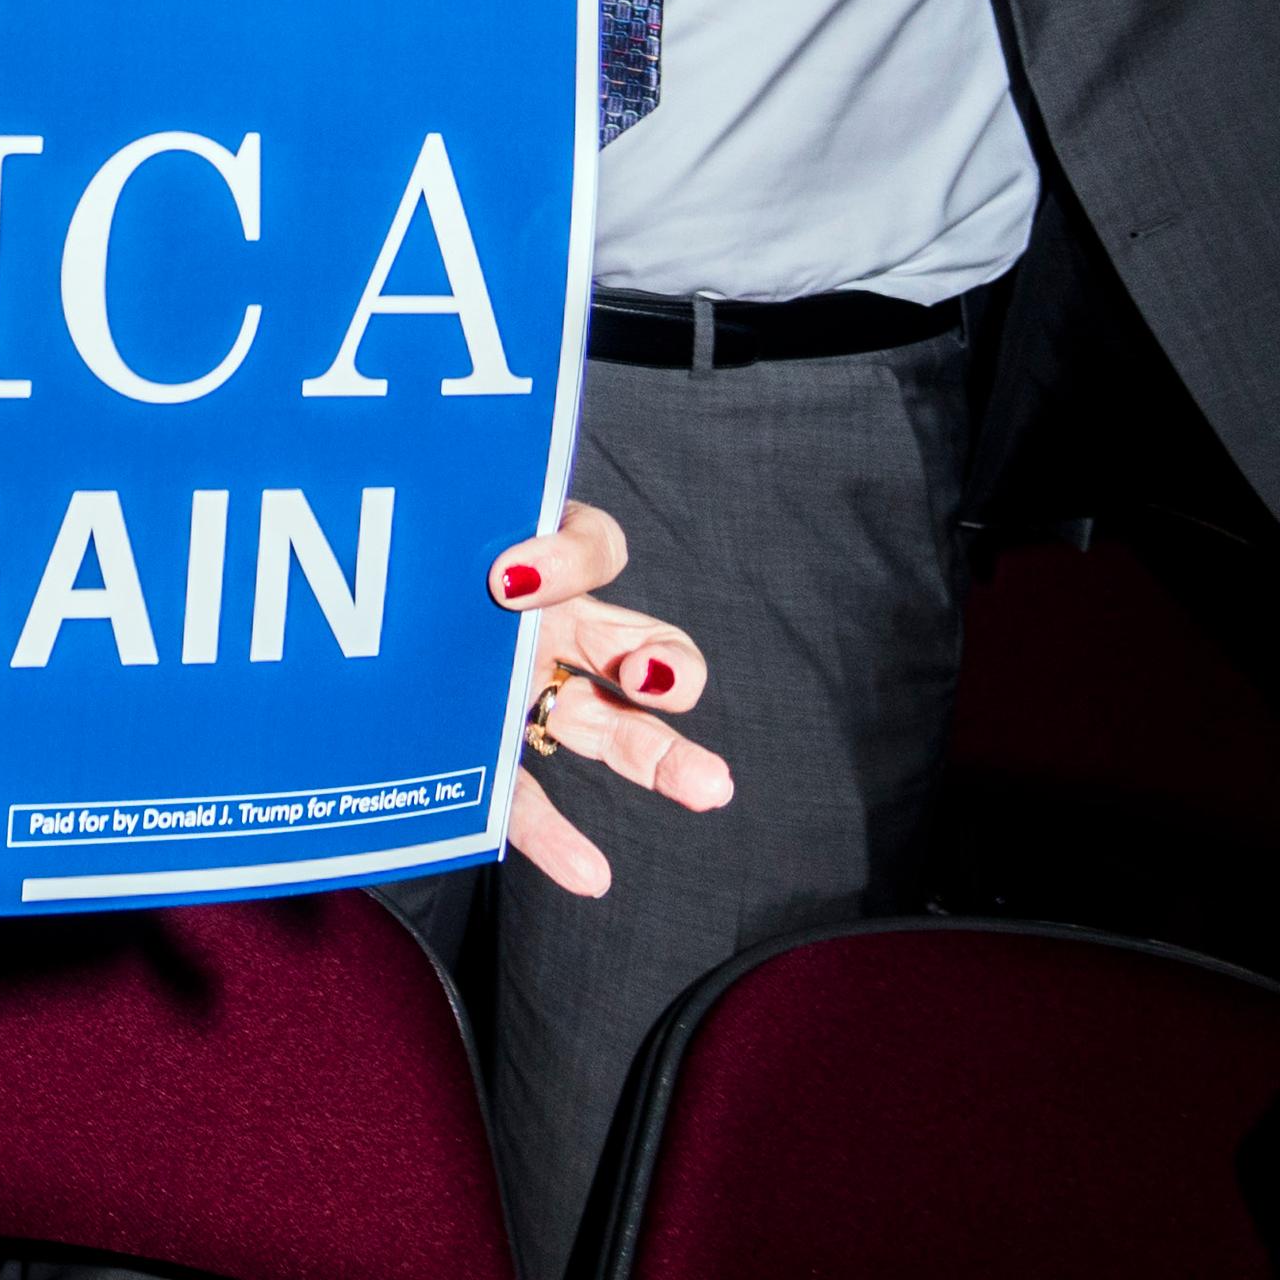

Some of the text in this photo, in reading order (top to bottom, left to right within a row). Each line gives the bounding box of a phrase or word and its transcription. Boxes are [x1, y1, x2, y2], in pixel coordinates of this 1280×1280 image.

[29, 780, 465, 836] Paid for by Donald J. Trump for President, Inc.
